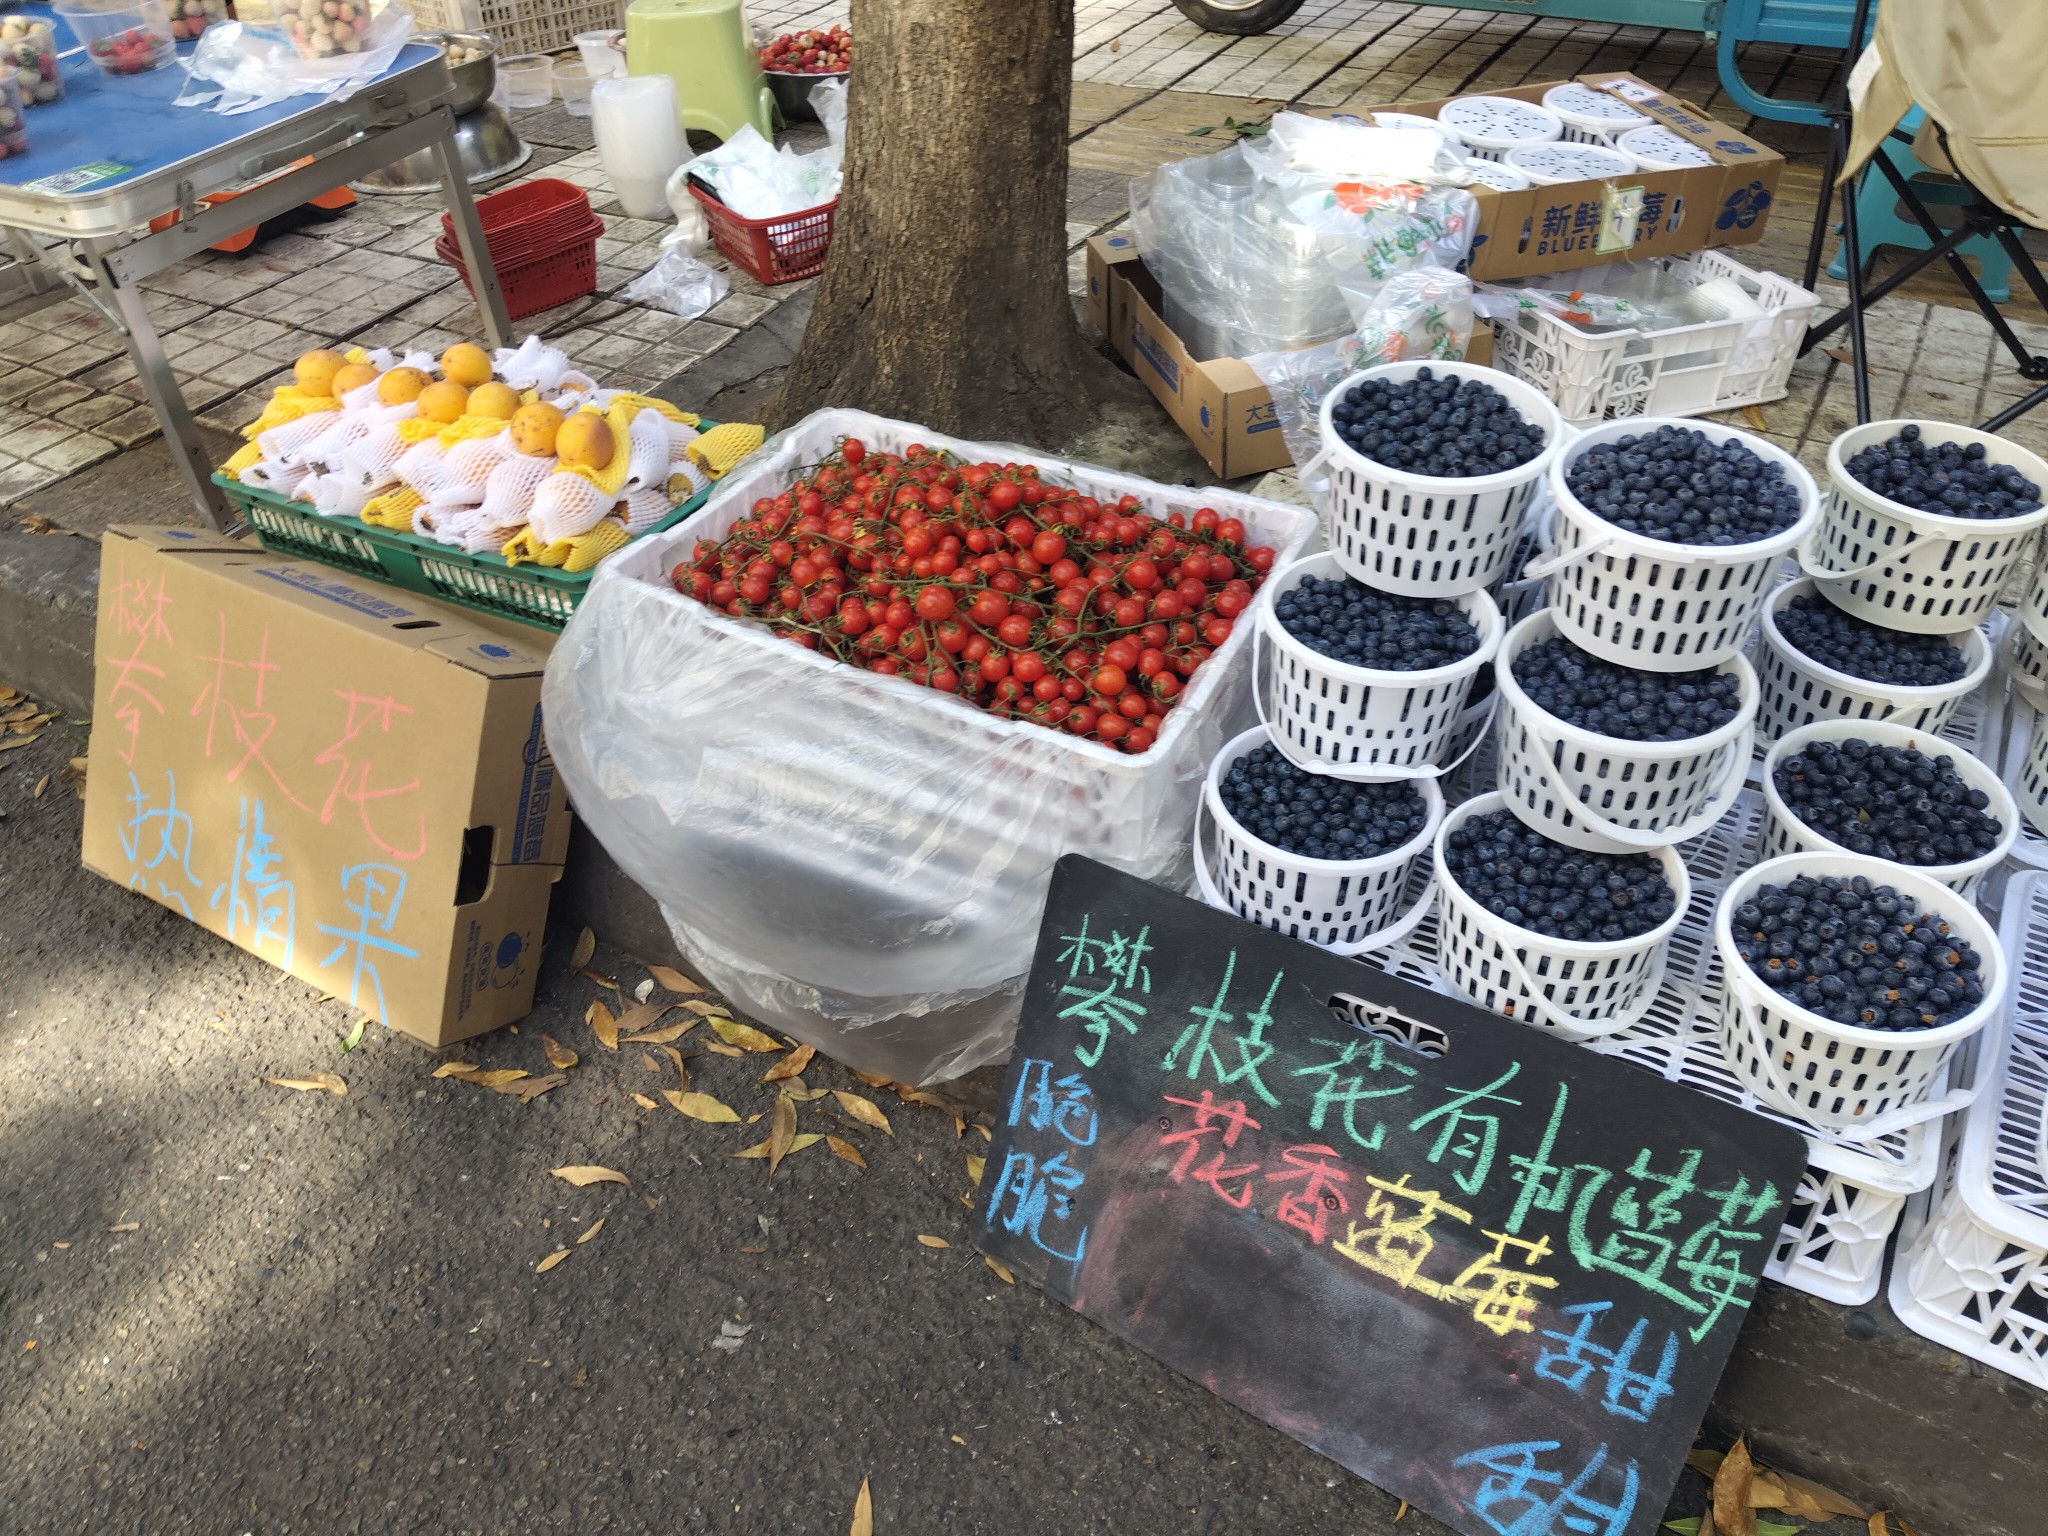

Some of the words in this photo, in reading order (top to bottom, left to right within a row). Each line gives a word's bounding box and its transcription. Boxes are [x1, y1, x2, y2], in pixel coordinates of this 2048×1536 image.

[1541, 191, 1667, 238] 新鲜莓
[1537, 226, 1657, 256] BLUEBRY
[118, 769, 422, 1028] 热情果
